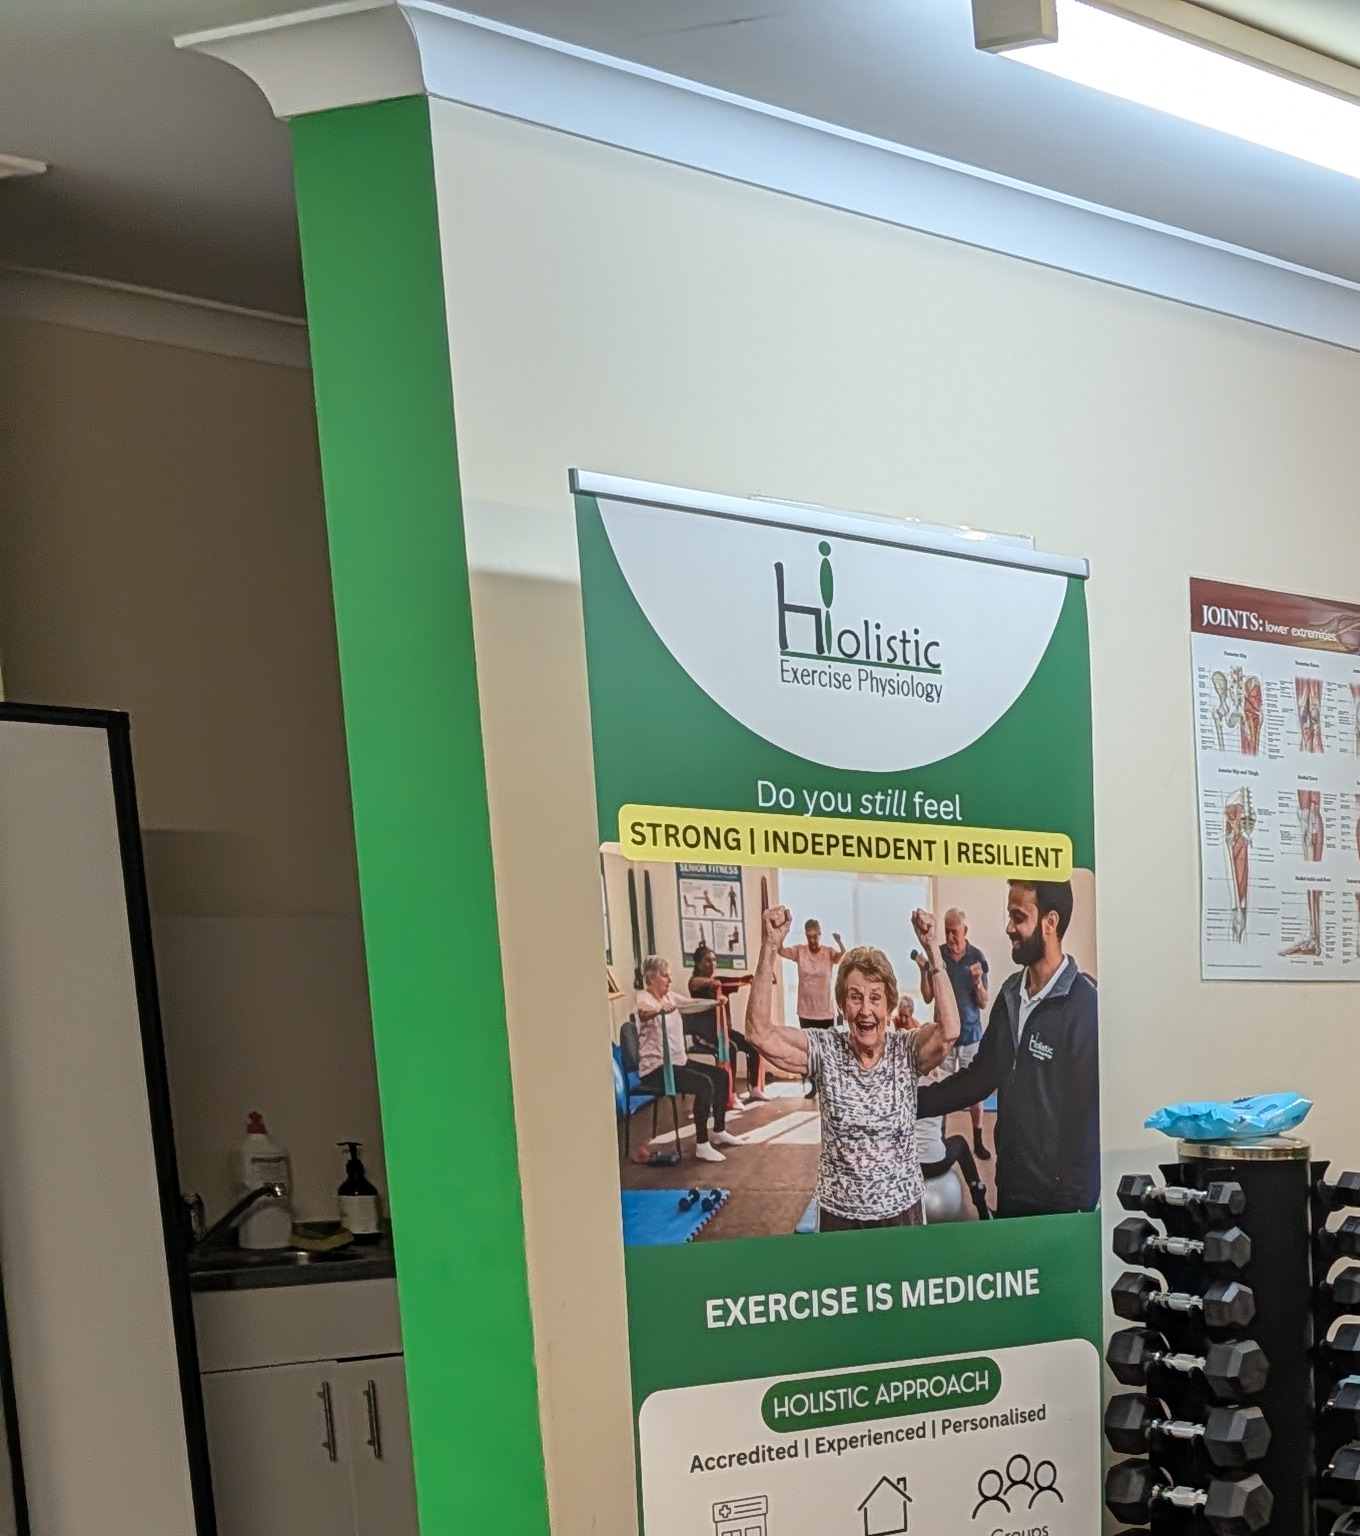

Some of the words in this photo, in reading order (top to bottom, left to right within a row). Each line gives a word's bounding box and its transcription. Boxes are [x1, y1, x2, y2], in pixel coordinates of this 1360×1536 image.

[1202, 605, 1263, 632] JOINTS:
[1265, 620, 1289, 635] lower
[1291, 628, 1336, 641] extremities
[780, 659, 852, 691] Exercise
[858, 667, 943, 704] Physiology
[757, 780, 795, 810] Do
[803, 790, 852, 818] you
[859, 788, 907, 818] still
[913, 791, 962, 821] feel
[629, 821, 742, 853] STRONG
[764, 830, 937, 862] INDEPENDENT
[956, 841, 1064, 870] RESILIENT
[705, 1286, 858, 1329] EXERCISE
[866, 1282, 893, 1312] IS
[901, 1268, 1040, 1309] MEDICINE
[773, 1386, 869, 1418] HOLISTIC
[875, 1370, 989, 1404] APPROACH
[689, 1443, 799, 1473] Accredited
[815, 1425, 927, 1458] Experienced
[941, 1404, 1047, 1437] Personalised
